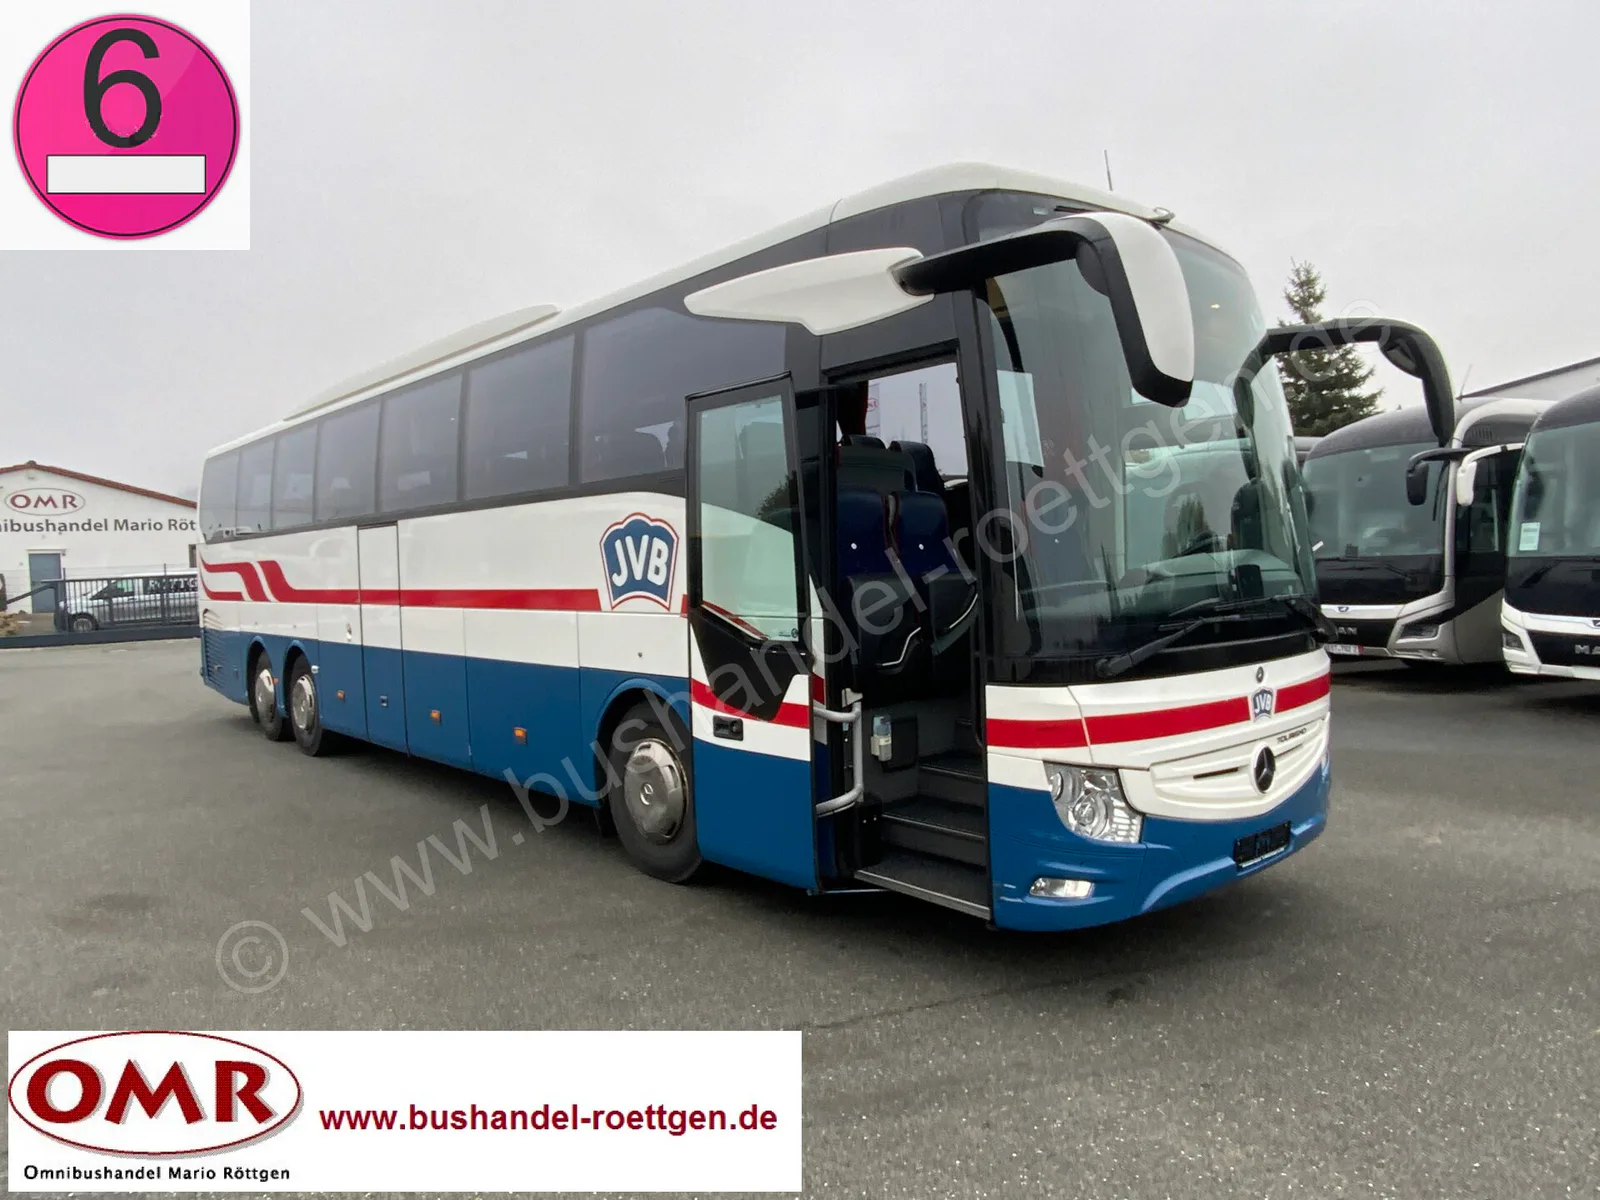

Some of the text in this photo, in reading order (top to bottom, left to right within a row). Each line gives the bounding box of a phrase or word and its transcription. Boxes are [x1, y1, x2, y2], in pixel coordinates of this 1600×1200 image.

[10, 494, 78, 509] OMR
[0, 518, 109, 532] ibushandel
[114, 518, 163, 531] Mario
[612, 534, 669, 587] JVB
[1254, 693, 1272, 714] JVB
